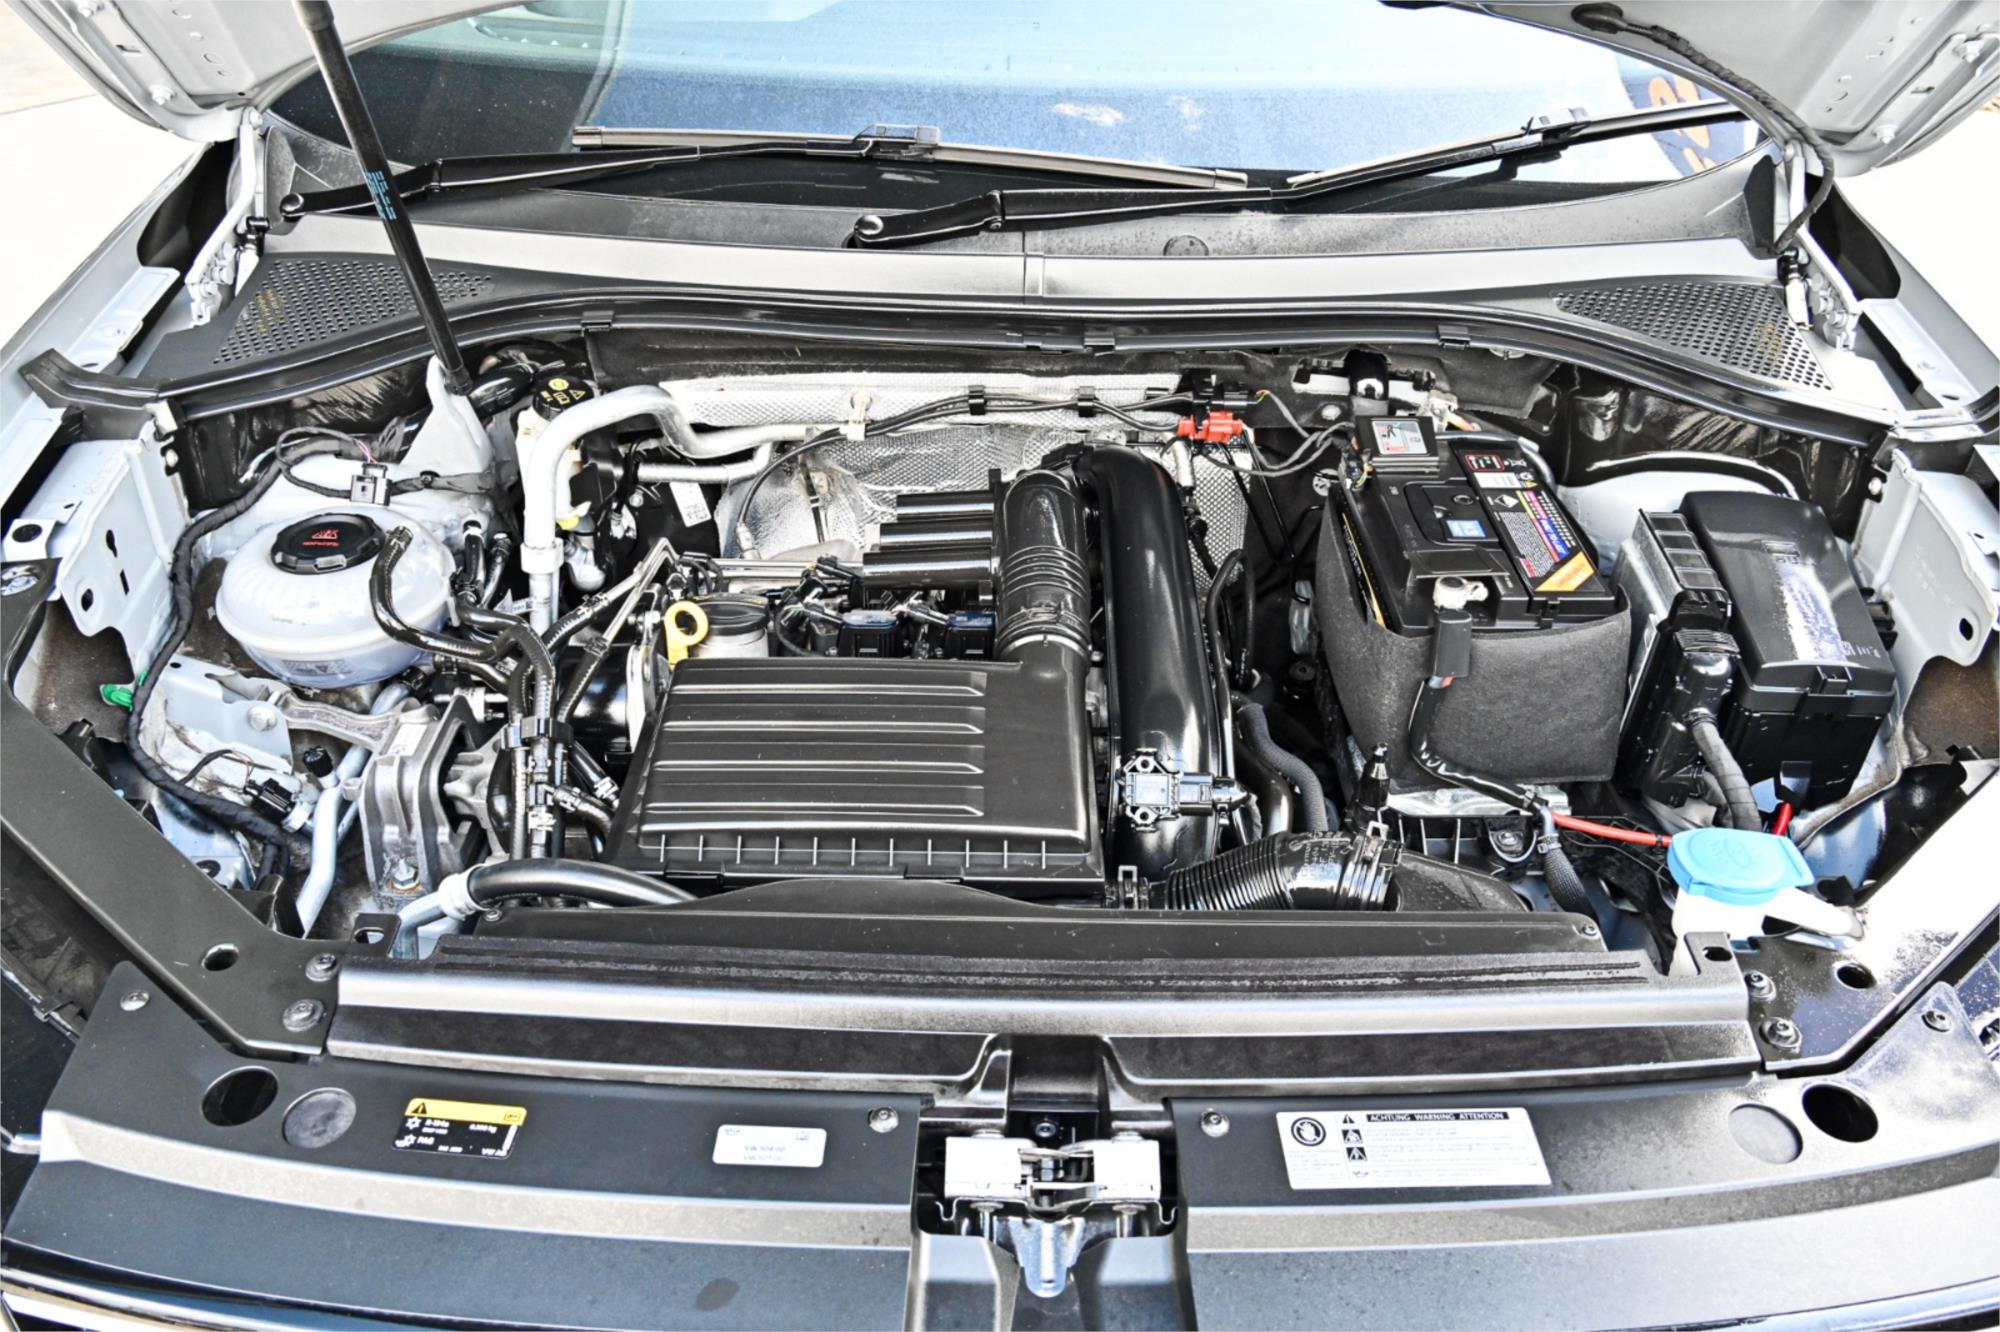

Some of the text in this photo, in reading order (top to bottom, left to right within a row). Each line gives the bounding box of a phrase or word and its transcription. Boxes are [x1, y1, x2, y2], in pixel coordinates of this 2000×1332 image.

[1370, 1112, 1505, 1121] ACHTUNG WARNING ATTENTION
